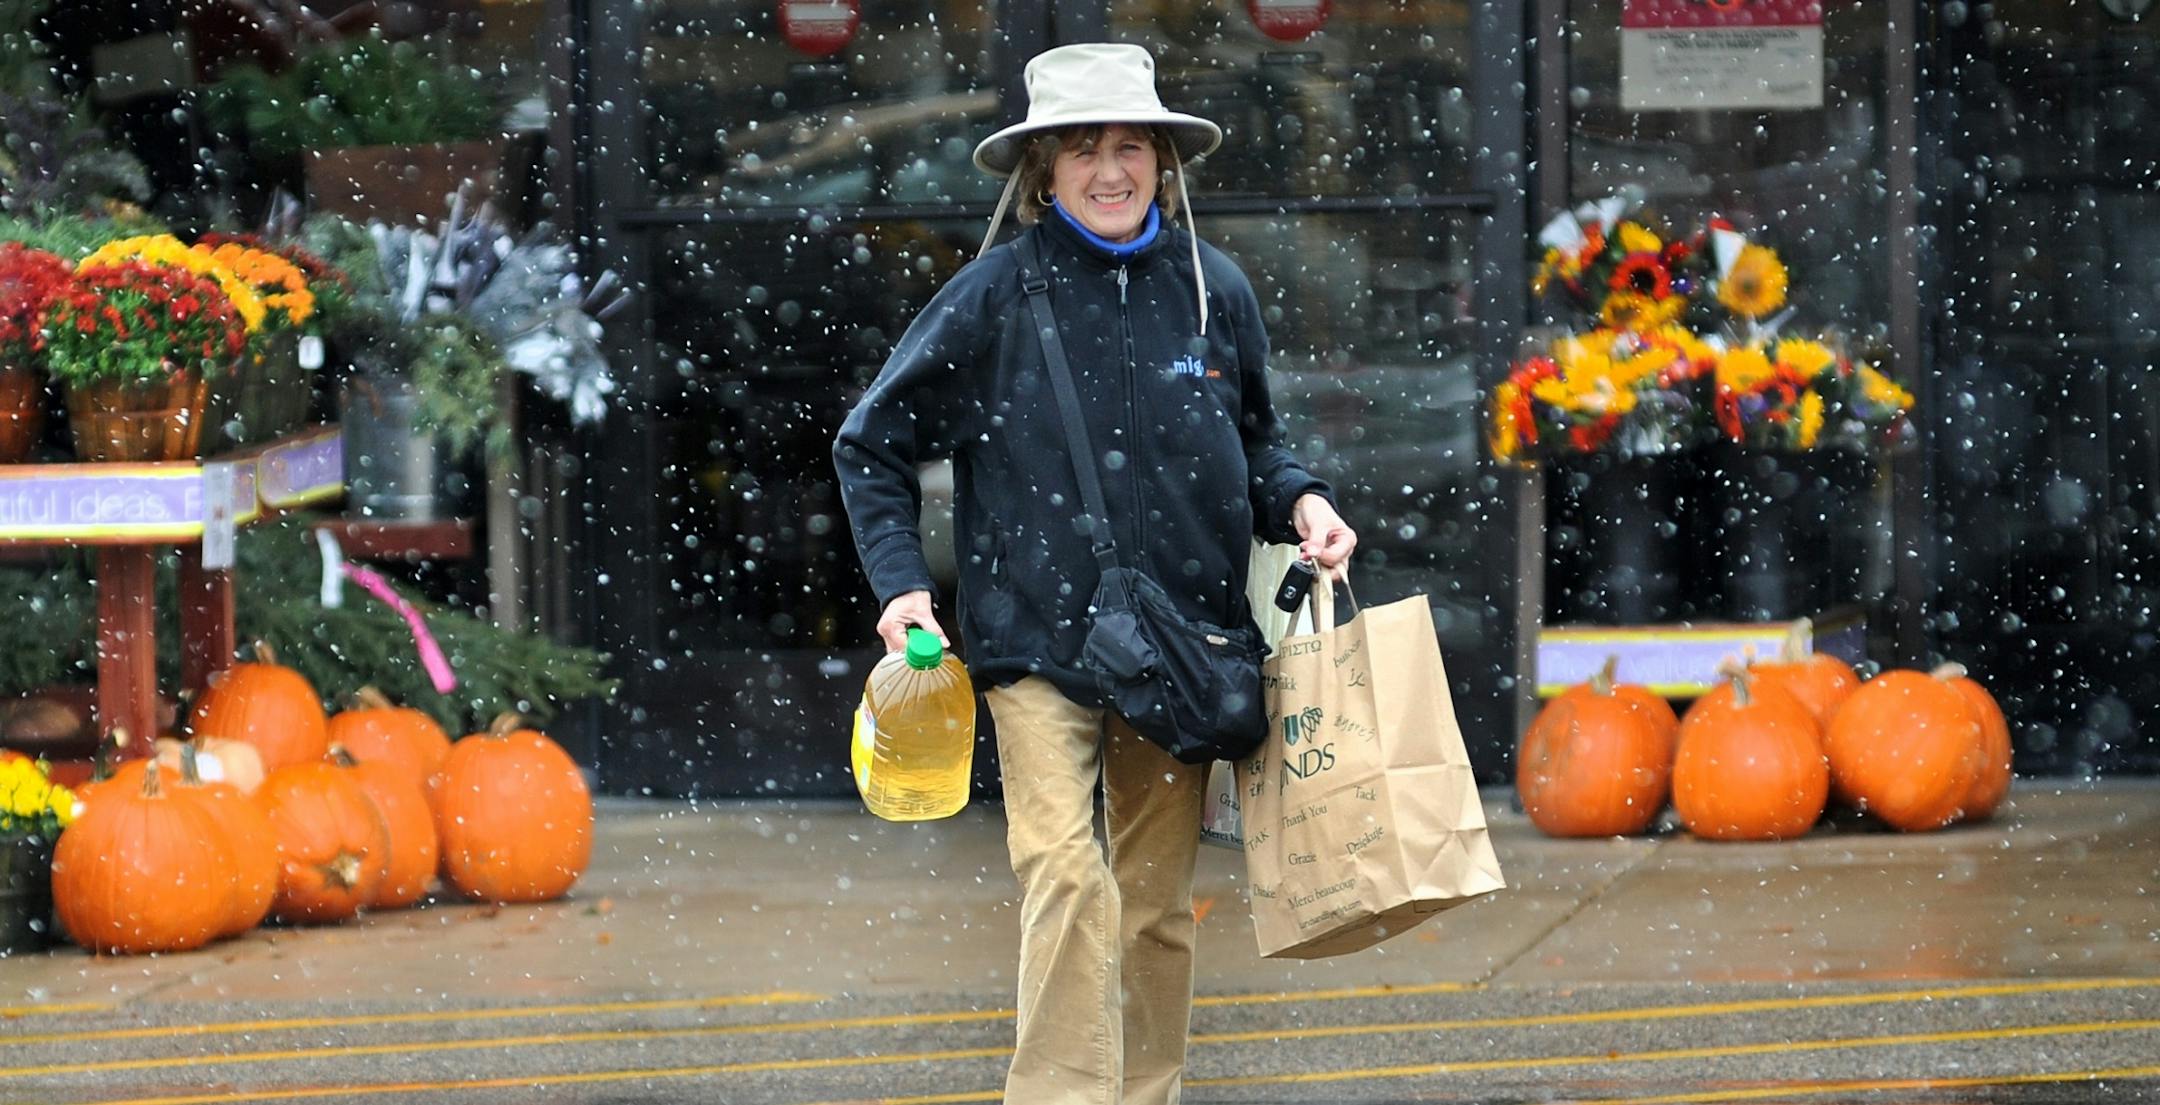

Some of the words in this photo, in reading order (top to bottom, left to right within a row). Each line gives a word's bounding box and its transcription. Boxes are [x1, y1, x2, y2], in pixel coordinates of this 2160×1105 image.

[1353, 785, 1377, 801] Tack
[1280, 811, 1307, 829] Thank
[1308, 804, 1327, 818] You
[1288, 853, 1317, 865] Grazie
[1288, 893, 1315, 910] Merci
[1315, 877, 1356, 900] beaucoup
